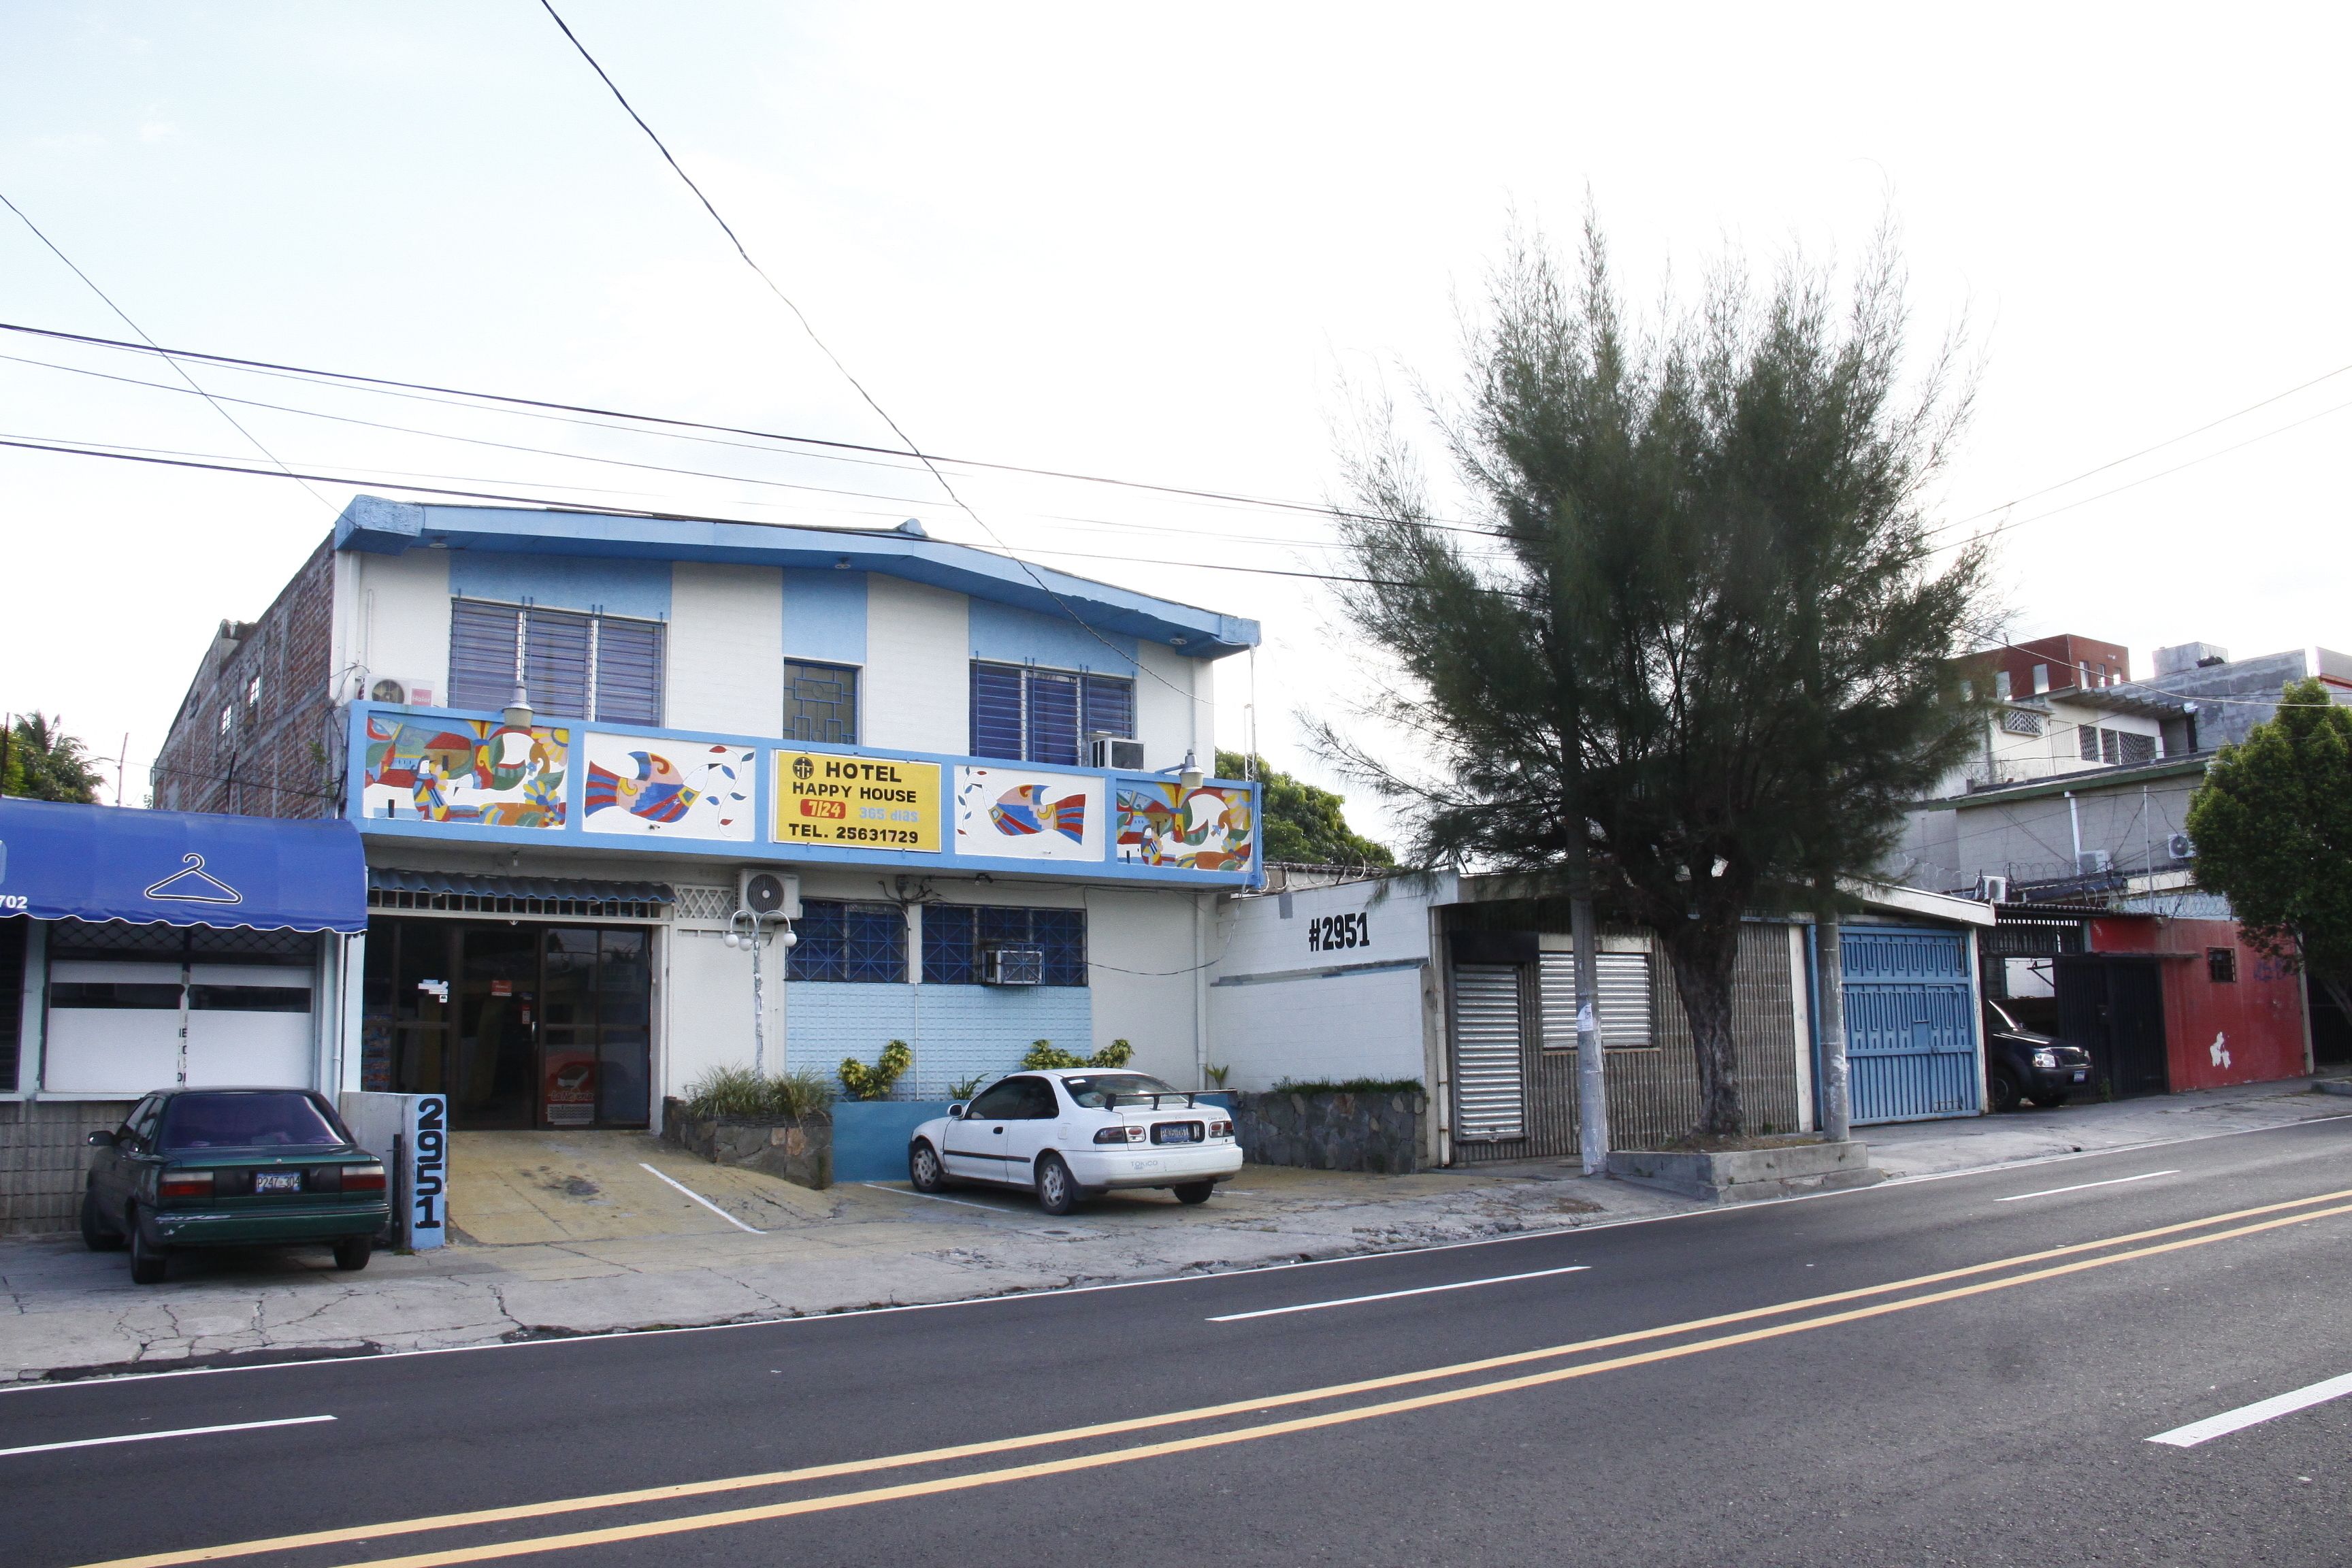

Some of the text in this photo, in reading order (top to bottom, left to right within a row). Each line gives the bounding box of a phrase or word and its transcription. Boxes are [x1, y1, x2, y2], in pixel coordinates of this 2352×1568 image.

[826, 761, 902, 783] HOTEL
[792, 781, 917, 803] HAPPY HOUSE
[859, 806, 885, 820] 365
[789, 823, 919, 844] TEL. 25631729
[1309, 912, 1370, 951] #2951
[414, 1098, 444, 1229] 2951
